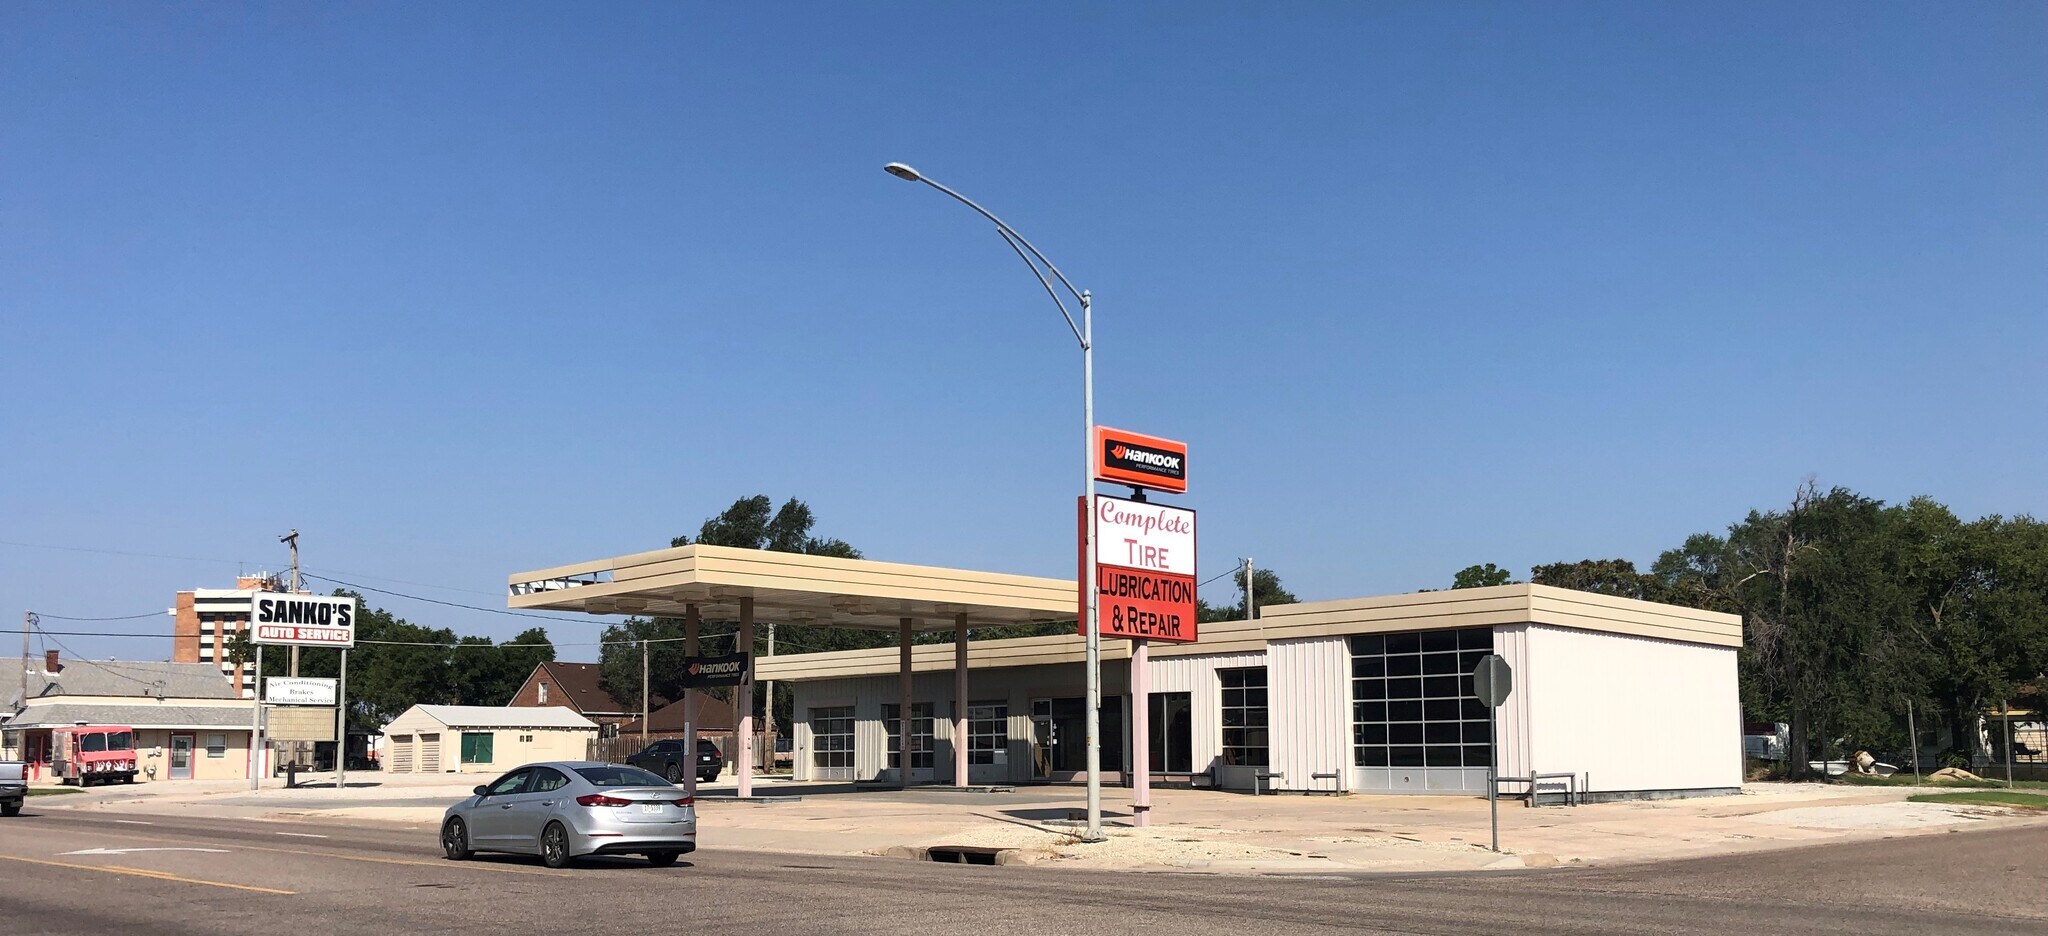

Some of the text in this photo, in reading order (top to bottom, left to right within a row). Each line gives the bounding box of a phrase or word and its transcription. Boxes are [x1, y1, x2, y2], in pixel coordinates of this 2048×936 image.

[1135, 463, 1166, 473] PERFORMANCE
[1100, 501, 1191, 535] Complete
[1124, 538, 1169, 569] TIRE
[1099, 567, 1192, 604] LUBRICATION
[259, 599, 351, 626] SANKO'S
[1112, 604, 1181, 637] & REPAIR
[260, 626, 349, 641] AUTO SERVICE
[283, 680, 334, 690] Conditioning
